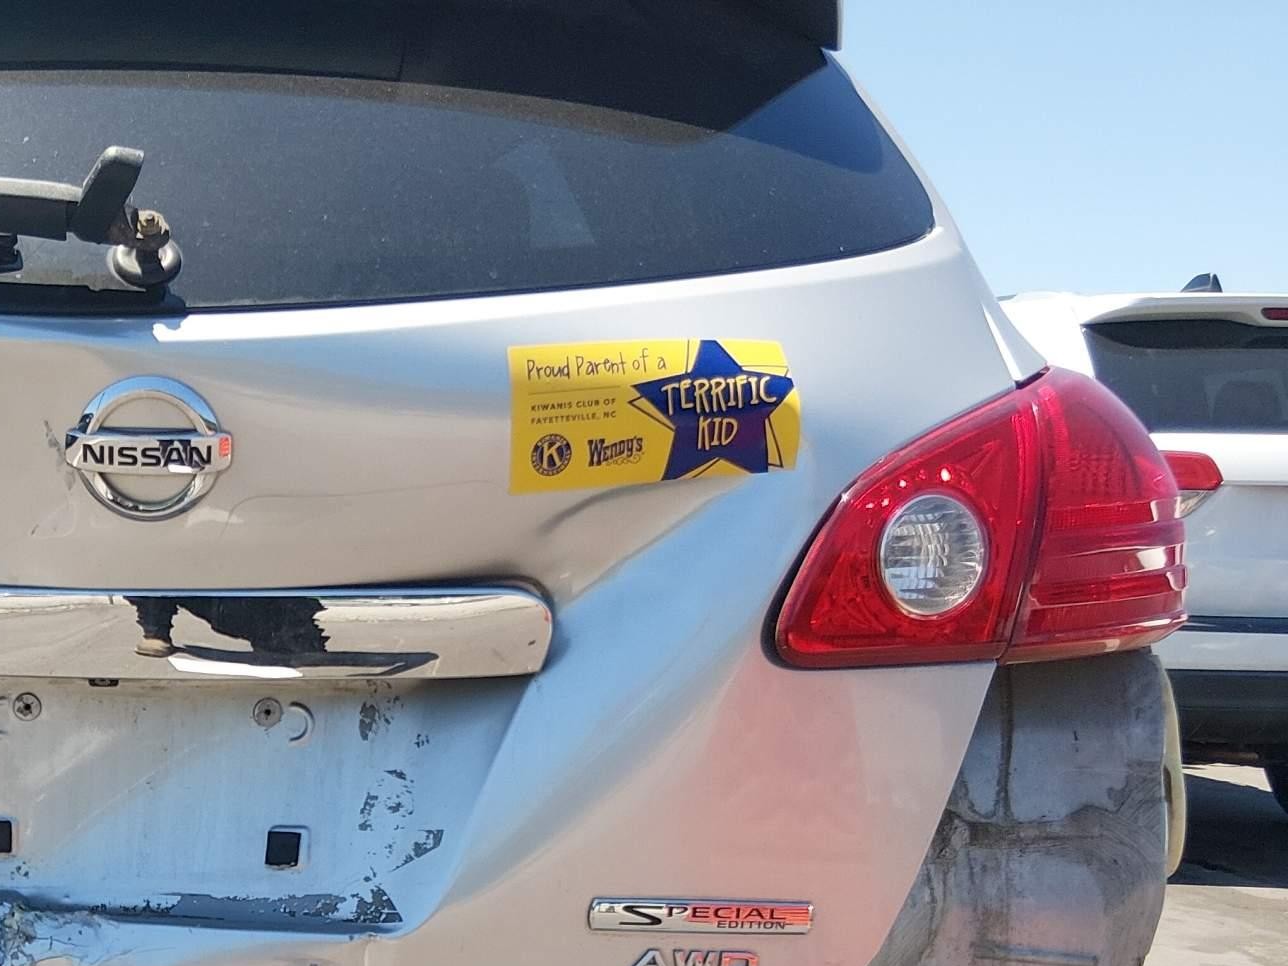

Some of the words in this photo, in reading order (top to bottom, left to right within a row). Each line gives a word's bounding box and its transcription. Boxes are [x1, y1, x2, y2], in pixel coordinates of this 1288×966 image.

[526, 357, 570, 380] Proud
[576, 352, 626, 376] Parent
[632, 348, 650, 371] of
[657, 356, 667, 370] a
[531, 401, 572, 412] KIWANIS
[575, 399, 600, 409] CLUB
[603, 398, 616, 406] OF
[660, 375, 777, 416] TERRIFIC
[530, 412, 601, 425] FAYETTEVILLE,
[697, 416, 738, 451] KID
[82, 443, 212, 467] NISSAN
[619, 905, 787, 926] SPECIAL
[716, 919, 787, 930] EDITION
